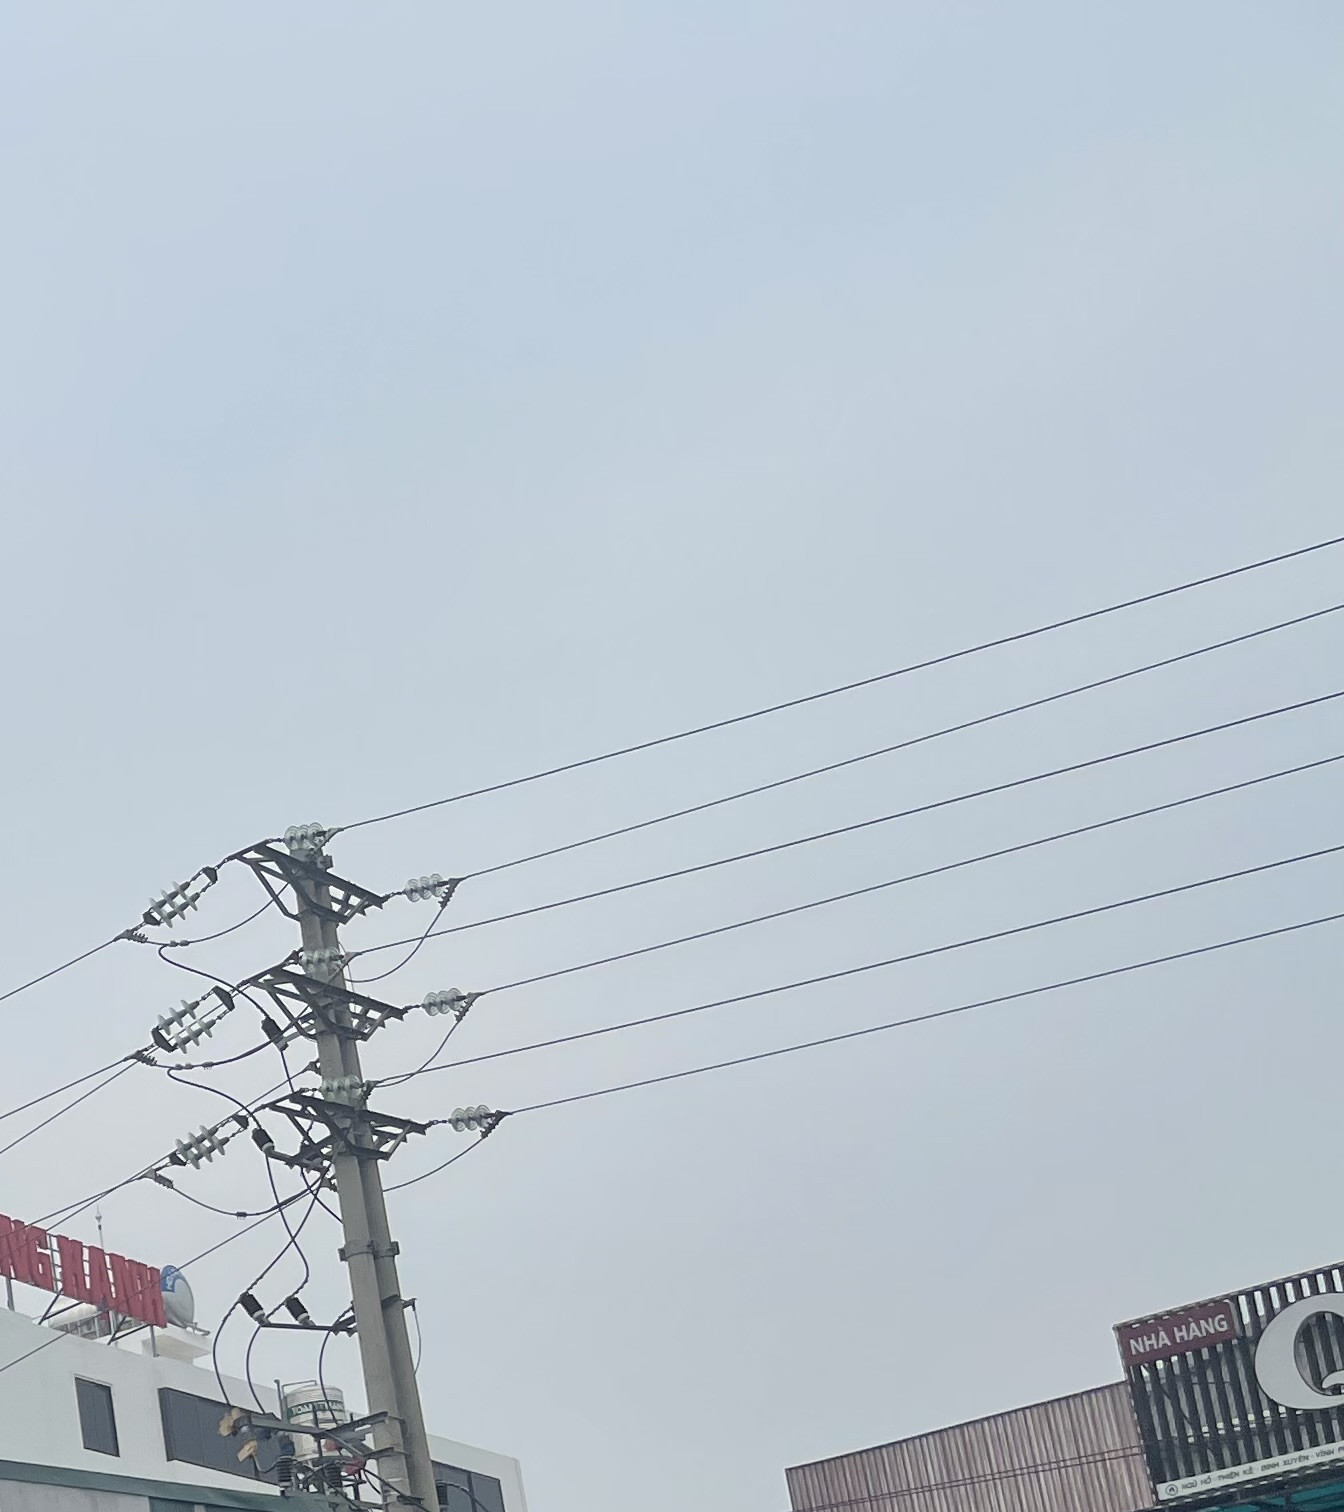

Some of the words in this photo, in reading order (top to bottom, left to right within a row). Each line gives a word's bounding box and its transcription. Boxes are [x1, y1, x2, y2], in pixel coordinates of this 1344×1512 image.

[56, 1233, 168, 1328] HẠNH
[1128, 1326, 1172, 1356] NHÀ
[1173, 1314, 1230, 1345] HÀNG
